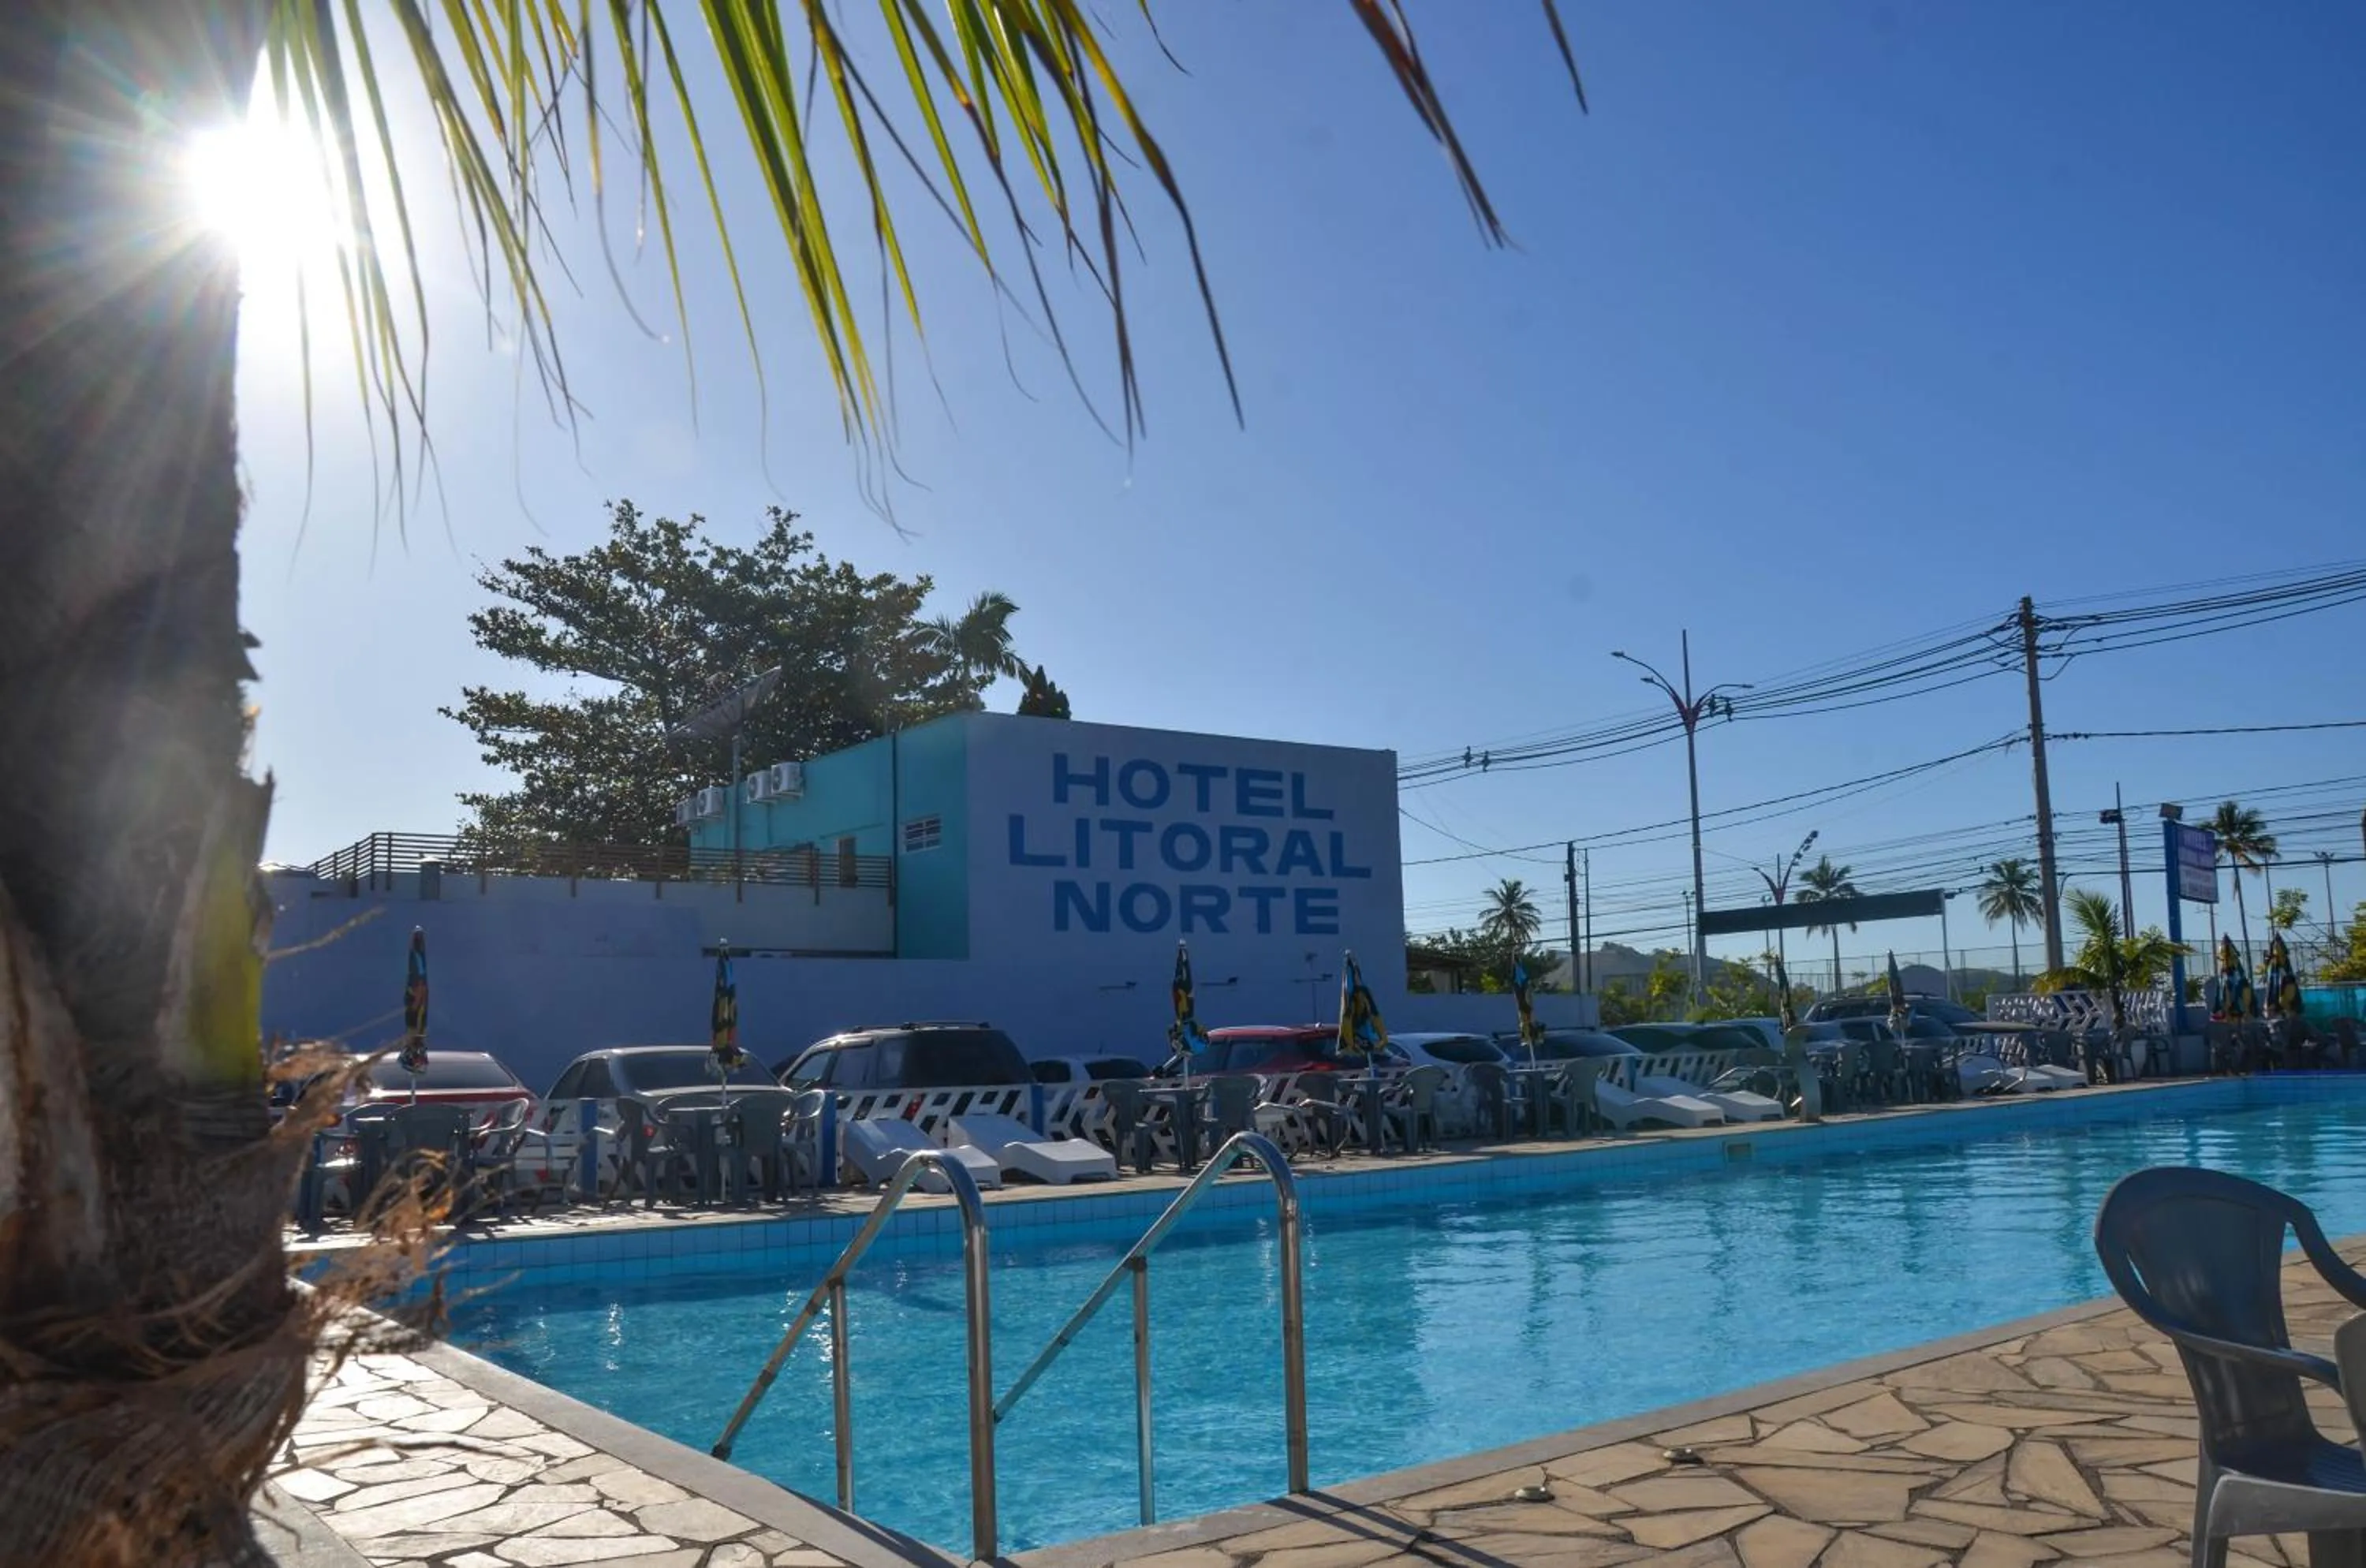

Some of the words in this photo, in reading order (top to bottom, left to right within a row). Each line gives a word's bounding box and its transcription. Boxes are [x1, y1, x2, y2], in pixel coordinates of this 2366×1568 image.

[1053, 753, 1334, 819] HOTEL
[1009, 815, 1371, 878] LITORAL
[1054, 881, 1340, 935] NORTE
